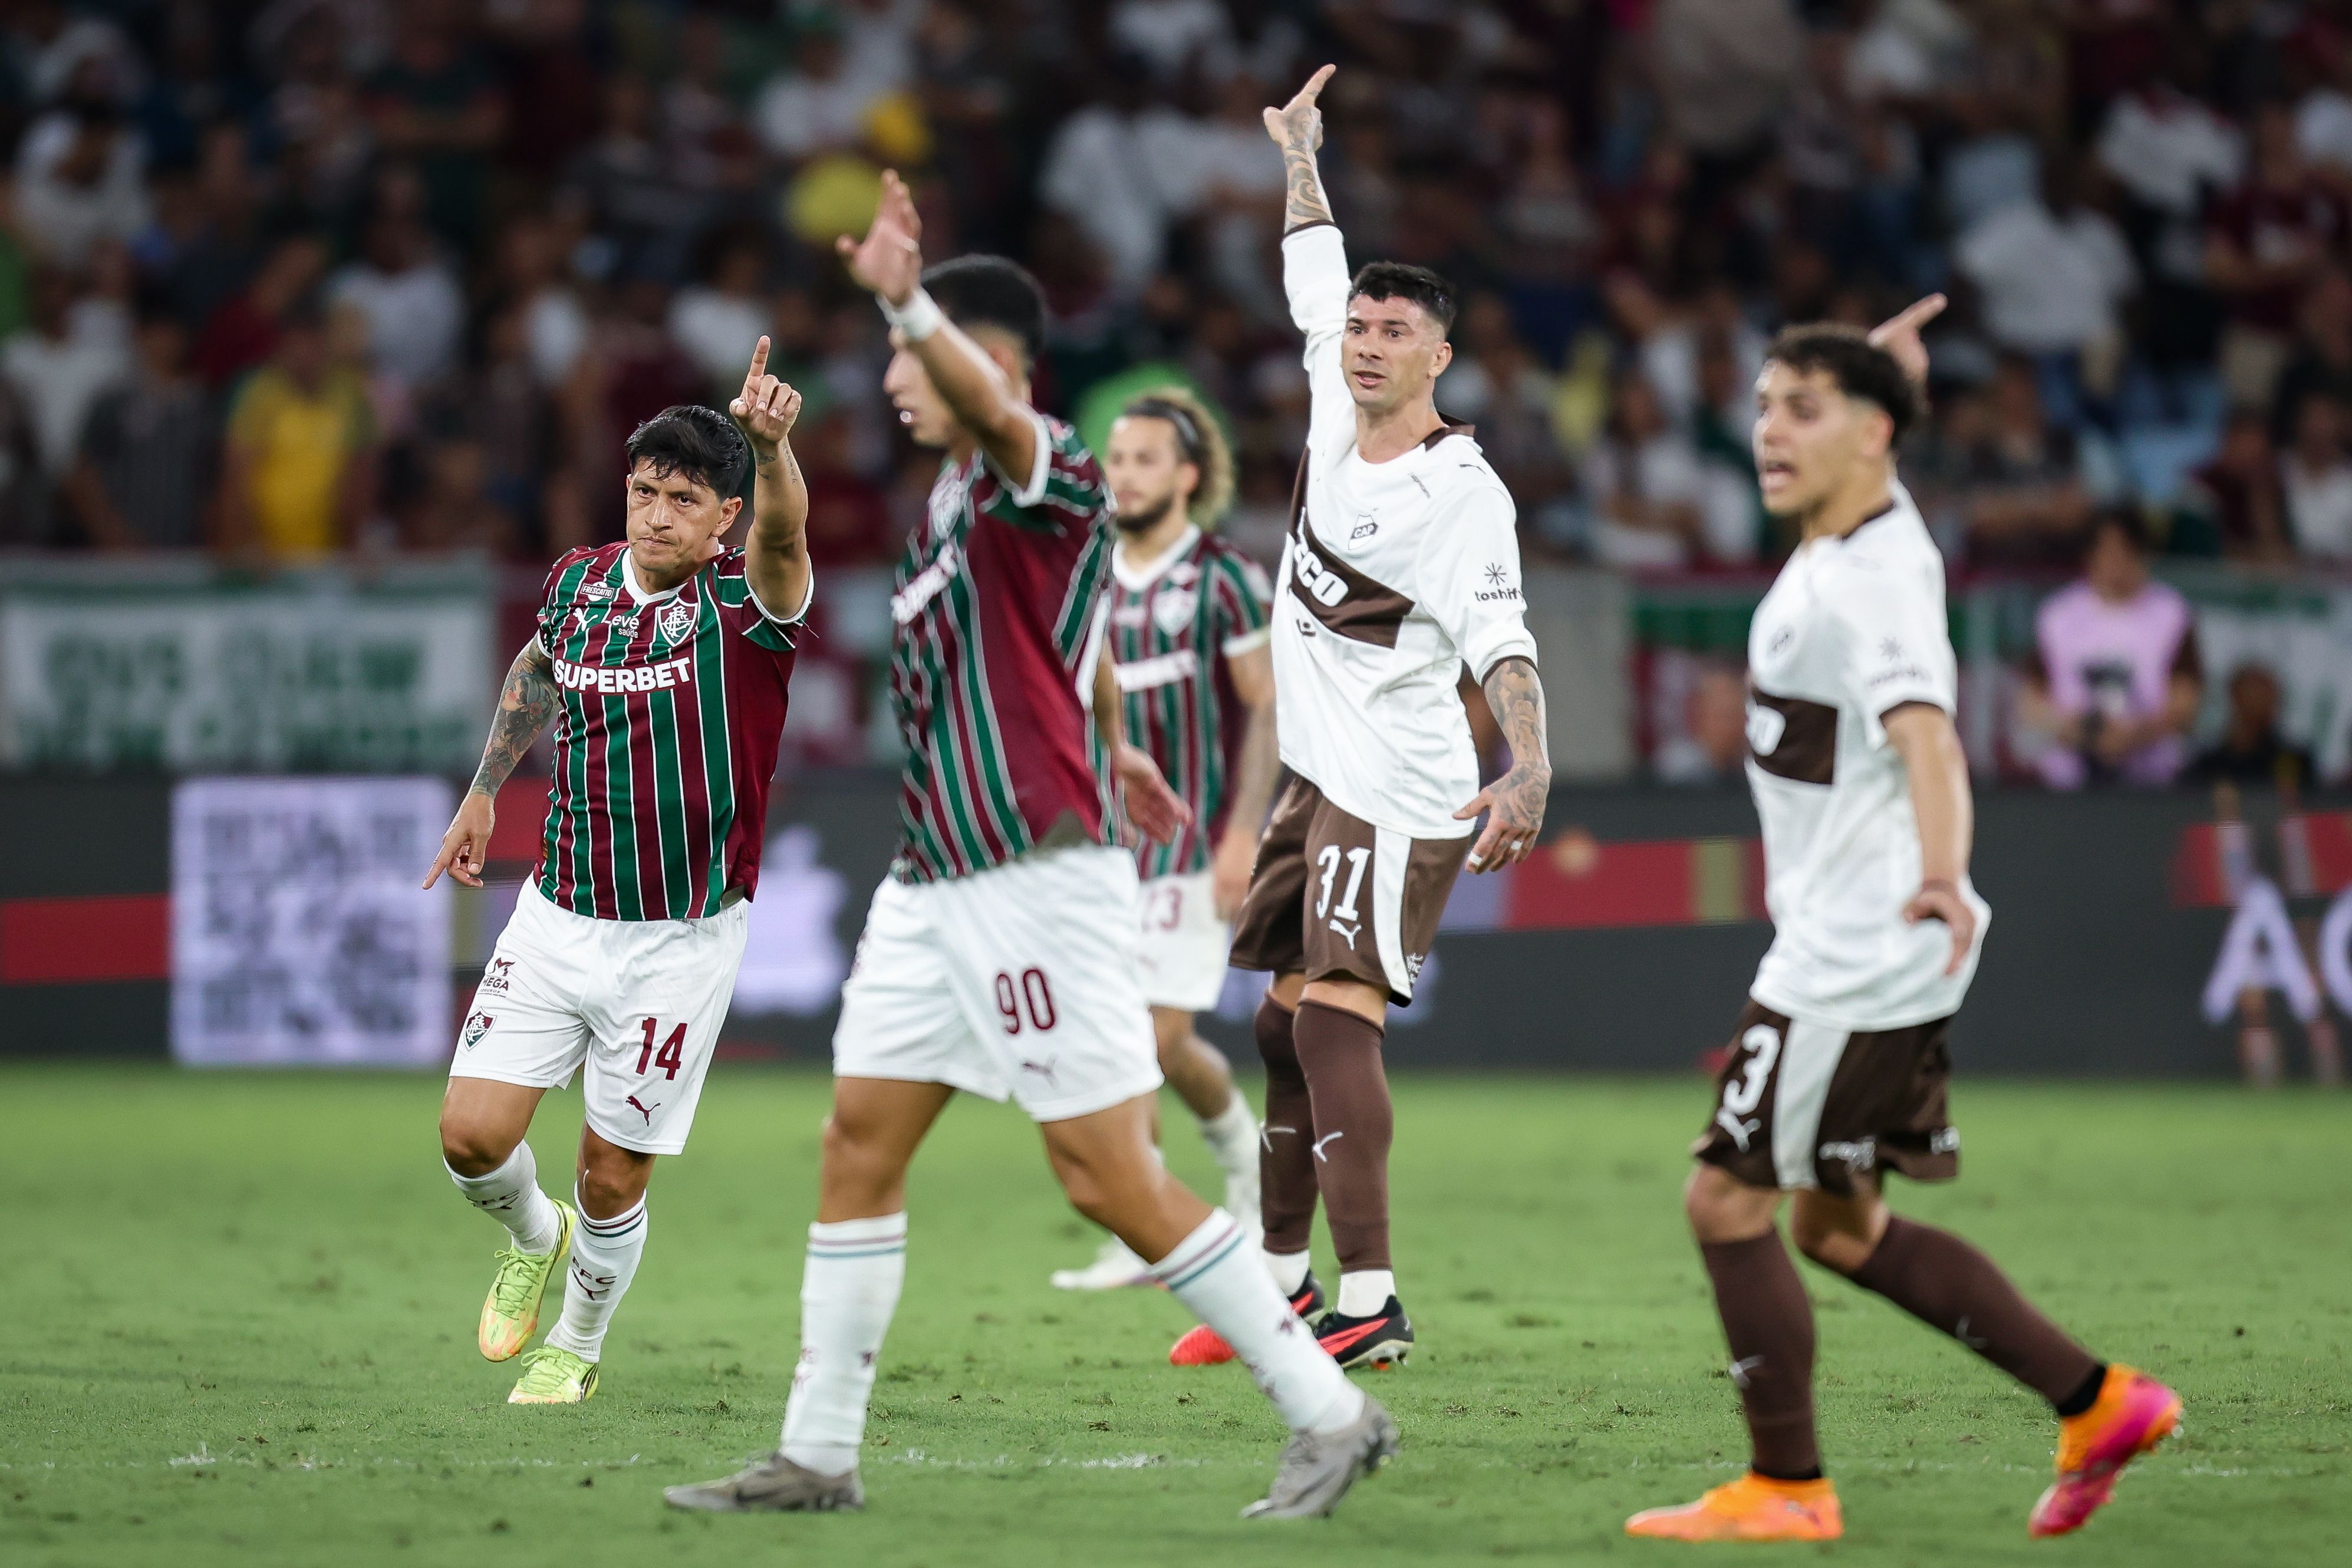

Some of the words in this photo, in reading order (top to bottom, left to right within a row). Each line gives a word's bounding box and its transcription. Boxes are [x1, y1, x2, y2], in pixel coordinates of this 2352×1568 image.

[582, 585, 612, 597] FRESCATTO
[618, 628, 638, 638] saúde
[554, 657, 690, 693] SUPERBET
[1316, 844, 1372, 922] 31
[482, 977, 509, 991] MEGA
[996, 969, 1056, 1035] 90
[635, 1017, 687, 1081] 14
[1723, 1023, 1781, 1116] 3
